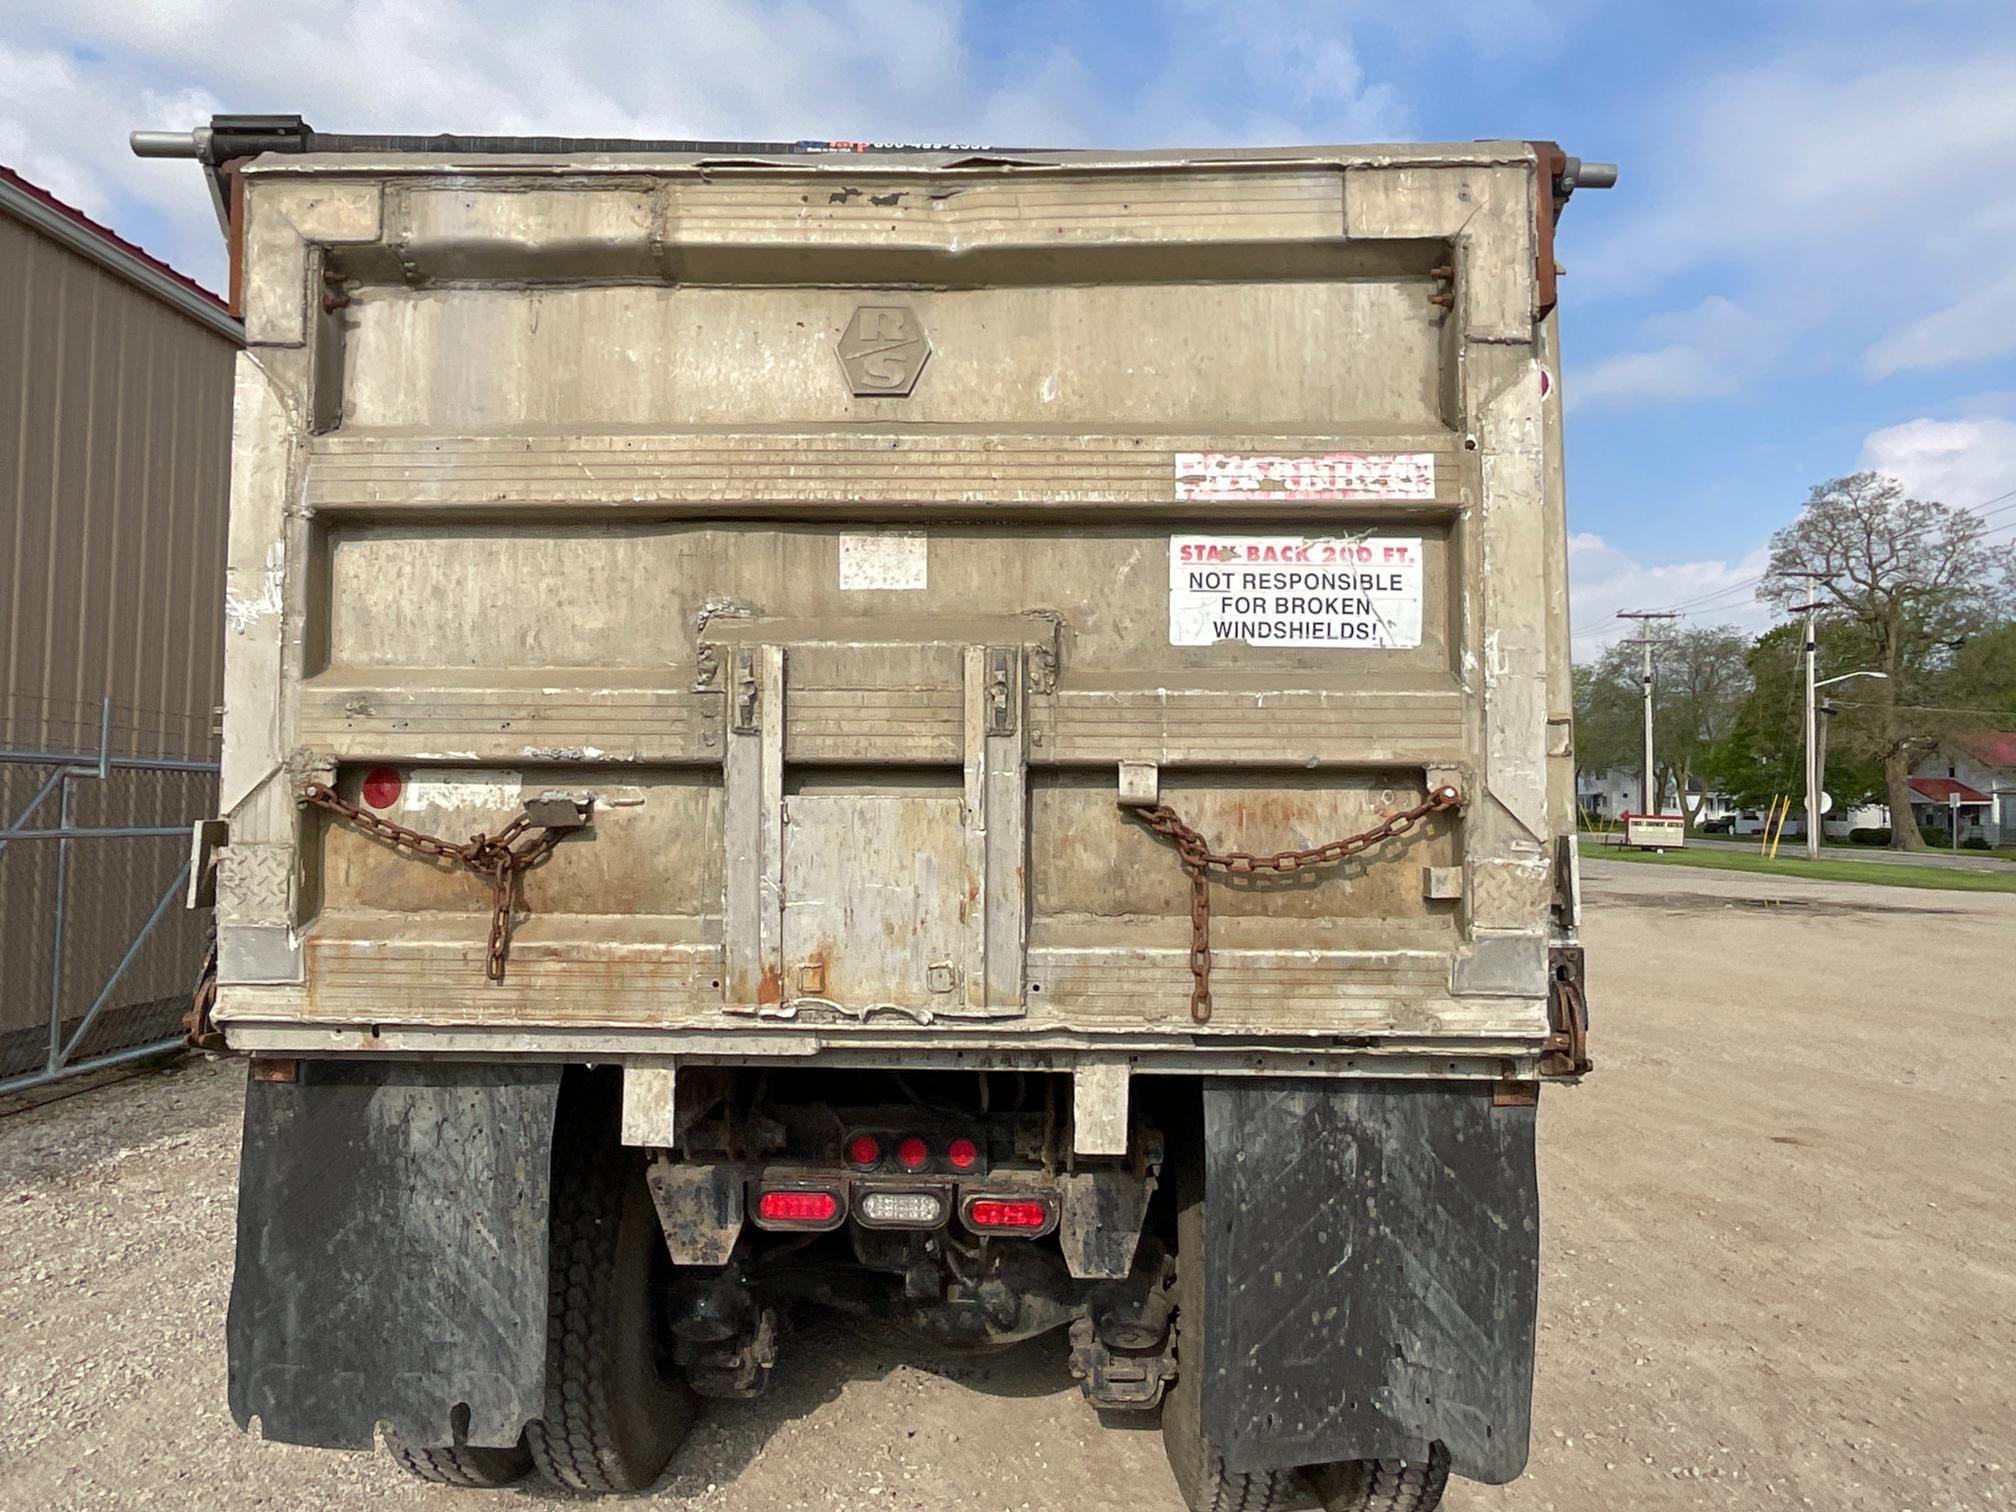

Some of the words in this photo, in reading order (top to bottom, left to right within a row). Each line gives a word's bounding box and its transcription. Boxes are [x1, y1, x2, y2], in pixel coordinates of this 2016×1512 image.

[1246, 546, 1311, 562] BACK
[1322, 546, 1373, 563] 200
[1383, 546, 1415, 564] FT.
[1189, 572, 1235, 590] NOT
[1242, 573, 1404, 591] RESPONSIBLE
[1221, 597, 1267, 614] FOR
[1275, 597, 1371, 615] BROKEN
[1213, 621, 1378, 641] WINDSHIELDS!
